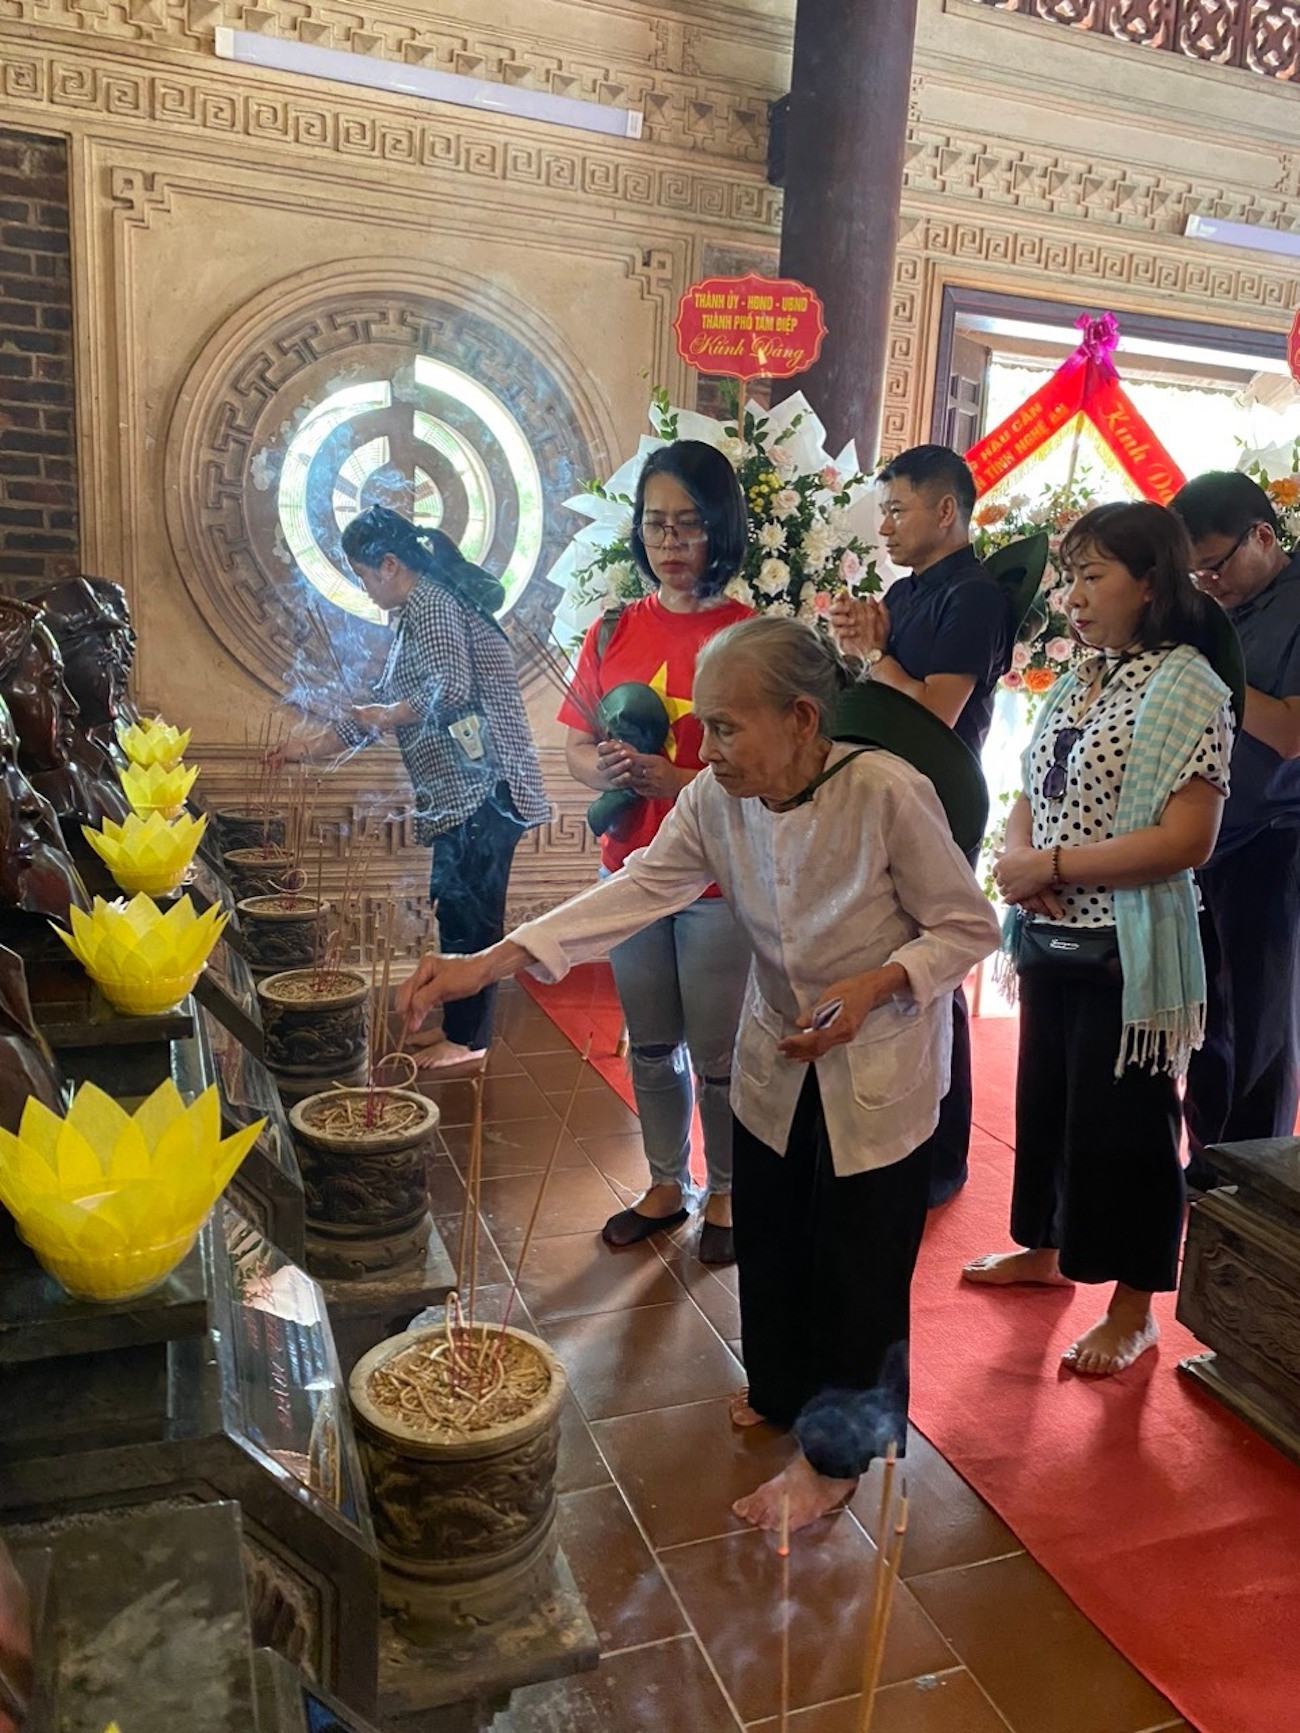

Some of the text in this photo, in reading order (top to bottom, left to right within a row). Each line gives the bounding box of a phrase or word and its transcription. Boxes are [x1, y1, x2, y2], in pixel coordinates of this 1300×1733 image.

[695, 290, 725, 309] THÀNH
[781, 296, 808, 312] UBND
[702, 311, 732, 330] THÀNH
[733, 311, 754, 330] PHỐ
[775, 314, 798, 335] ĐIỆP
[689, 331, 745, 356] Kính
[1101, 402, 1150, 464] Kính
